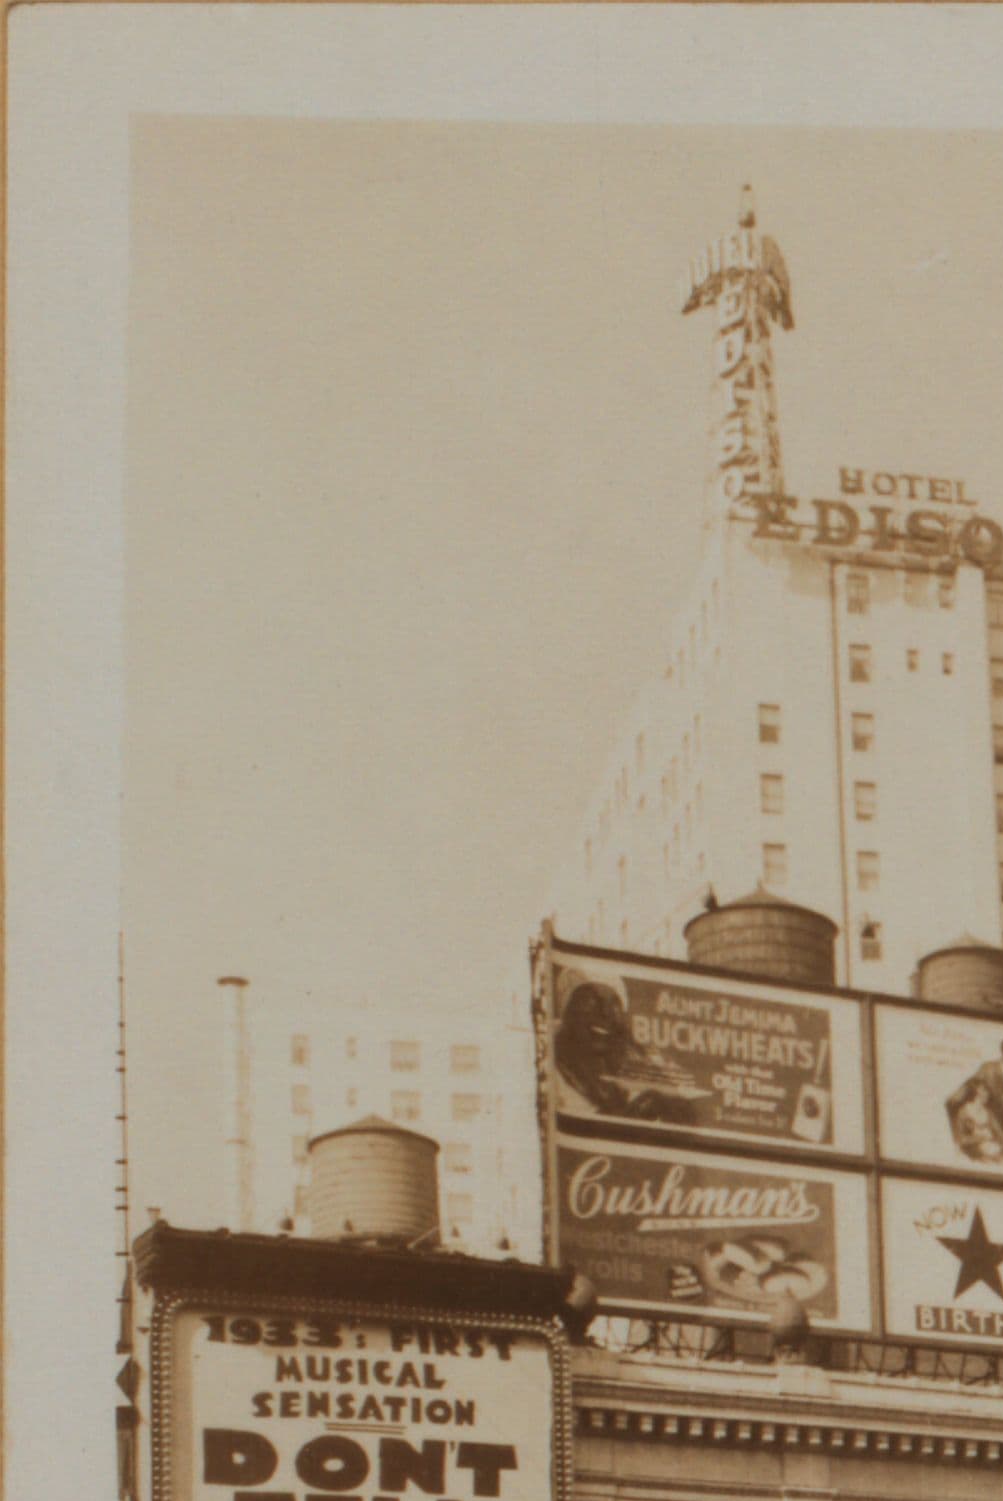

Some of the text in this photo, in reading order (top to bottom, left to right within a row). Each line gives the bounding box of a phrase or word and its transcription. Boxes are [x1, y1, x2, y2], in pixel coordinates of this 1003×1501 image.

[839, 467, 979, 507] HOTEL
[655, 991, 798, 1034] AUNT JEMIMA
[568, 1155, 820, 1222] Cushman's
[913, 1202, 968, 1238] NOW
[389, 1322, 517, 1361] FIRST
[275, 1354, 446, 1390] MUSICAL
[251, 1389, 476, 1426] SENSATION
[202, 1427, 518, 1498] DON'T
